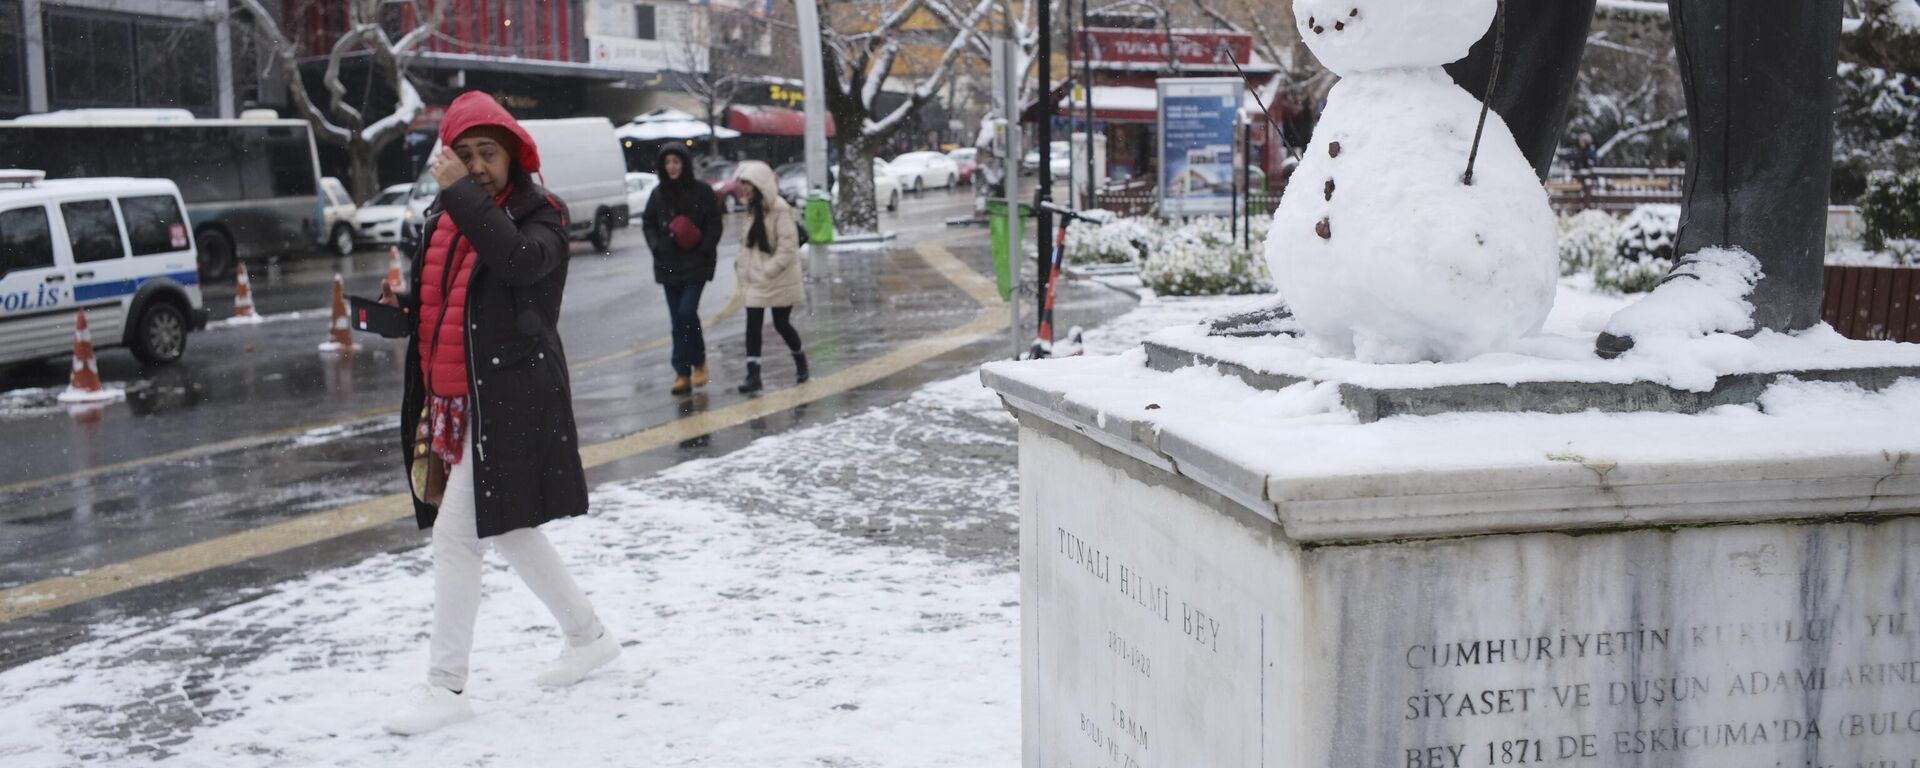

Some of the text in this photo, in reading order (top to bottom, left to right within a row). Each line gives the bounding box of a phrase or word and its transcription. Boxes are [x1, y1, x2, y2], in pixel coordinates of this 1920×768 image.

[0, 283, 60, 313] OLİS
[1058, 527, 1221, 652] TUNALI HİLMİ BEY
[1405, 623, 1670, 670] CUMHURİYETİN
[1404, 688, 1536, 721] SİYASET
[1552, 683, 1591, 708] VE
[1404, 743, 1467, 768] BEY
[1487, 738, 1544, 766] 1871
[1556, 733, 1598, 761] DE
